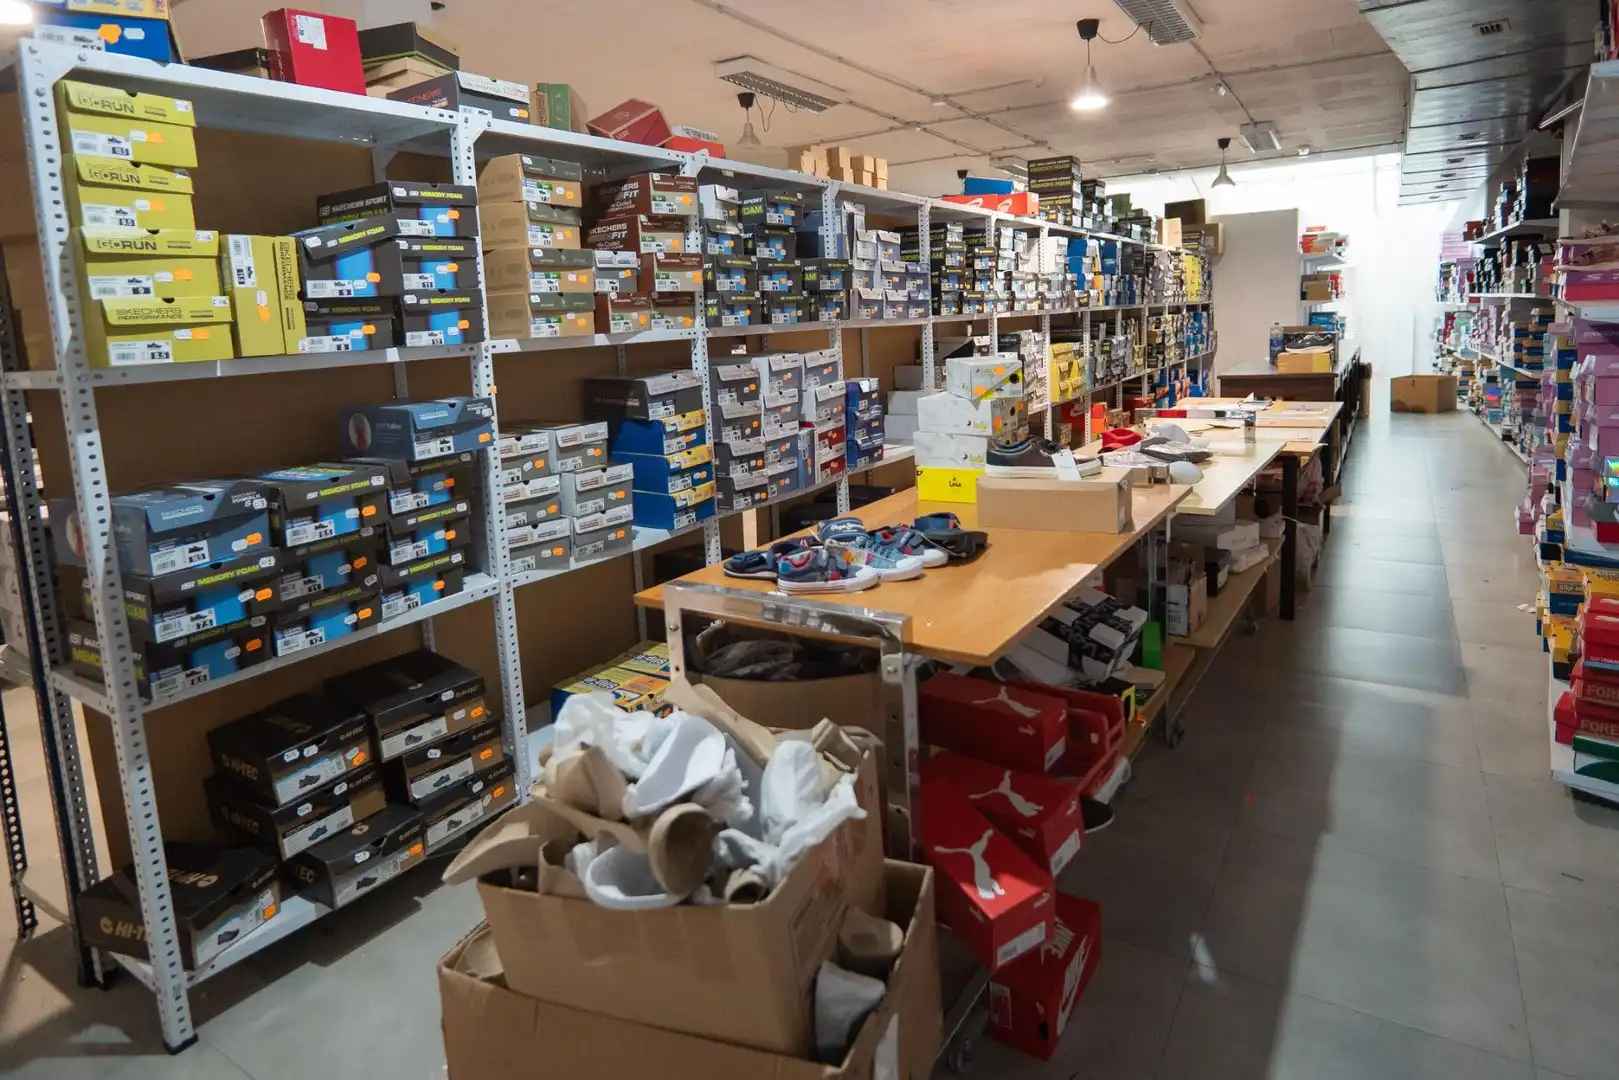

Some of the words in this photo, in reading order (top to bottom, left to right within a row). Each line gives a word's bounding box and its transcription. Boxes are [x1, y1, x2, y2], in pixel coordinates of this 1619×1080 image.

[365, 195, 388, 209] SPORT
[284, 242, 296, 300] SKECHERS
[116, 307, 182, 316] SKECHERS
[197, 571, 235, 585] MEMORY
[230, 757, 259, 781] HI-TEC
[115, 922, 148, 941] HI-T
